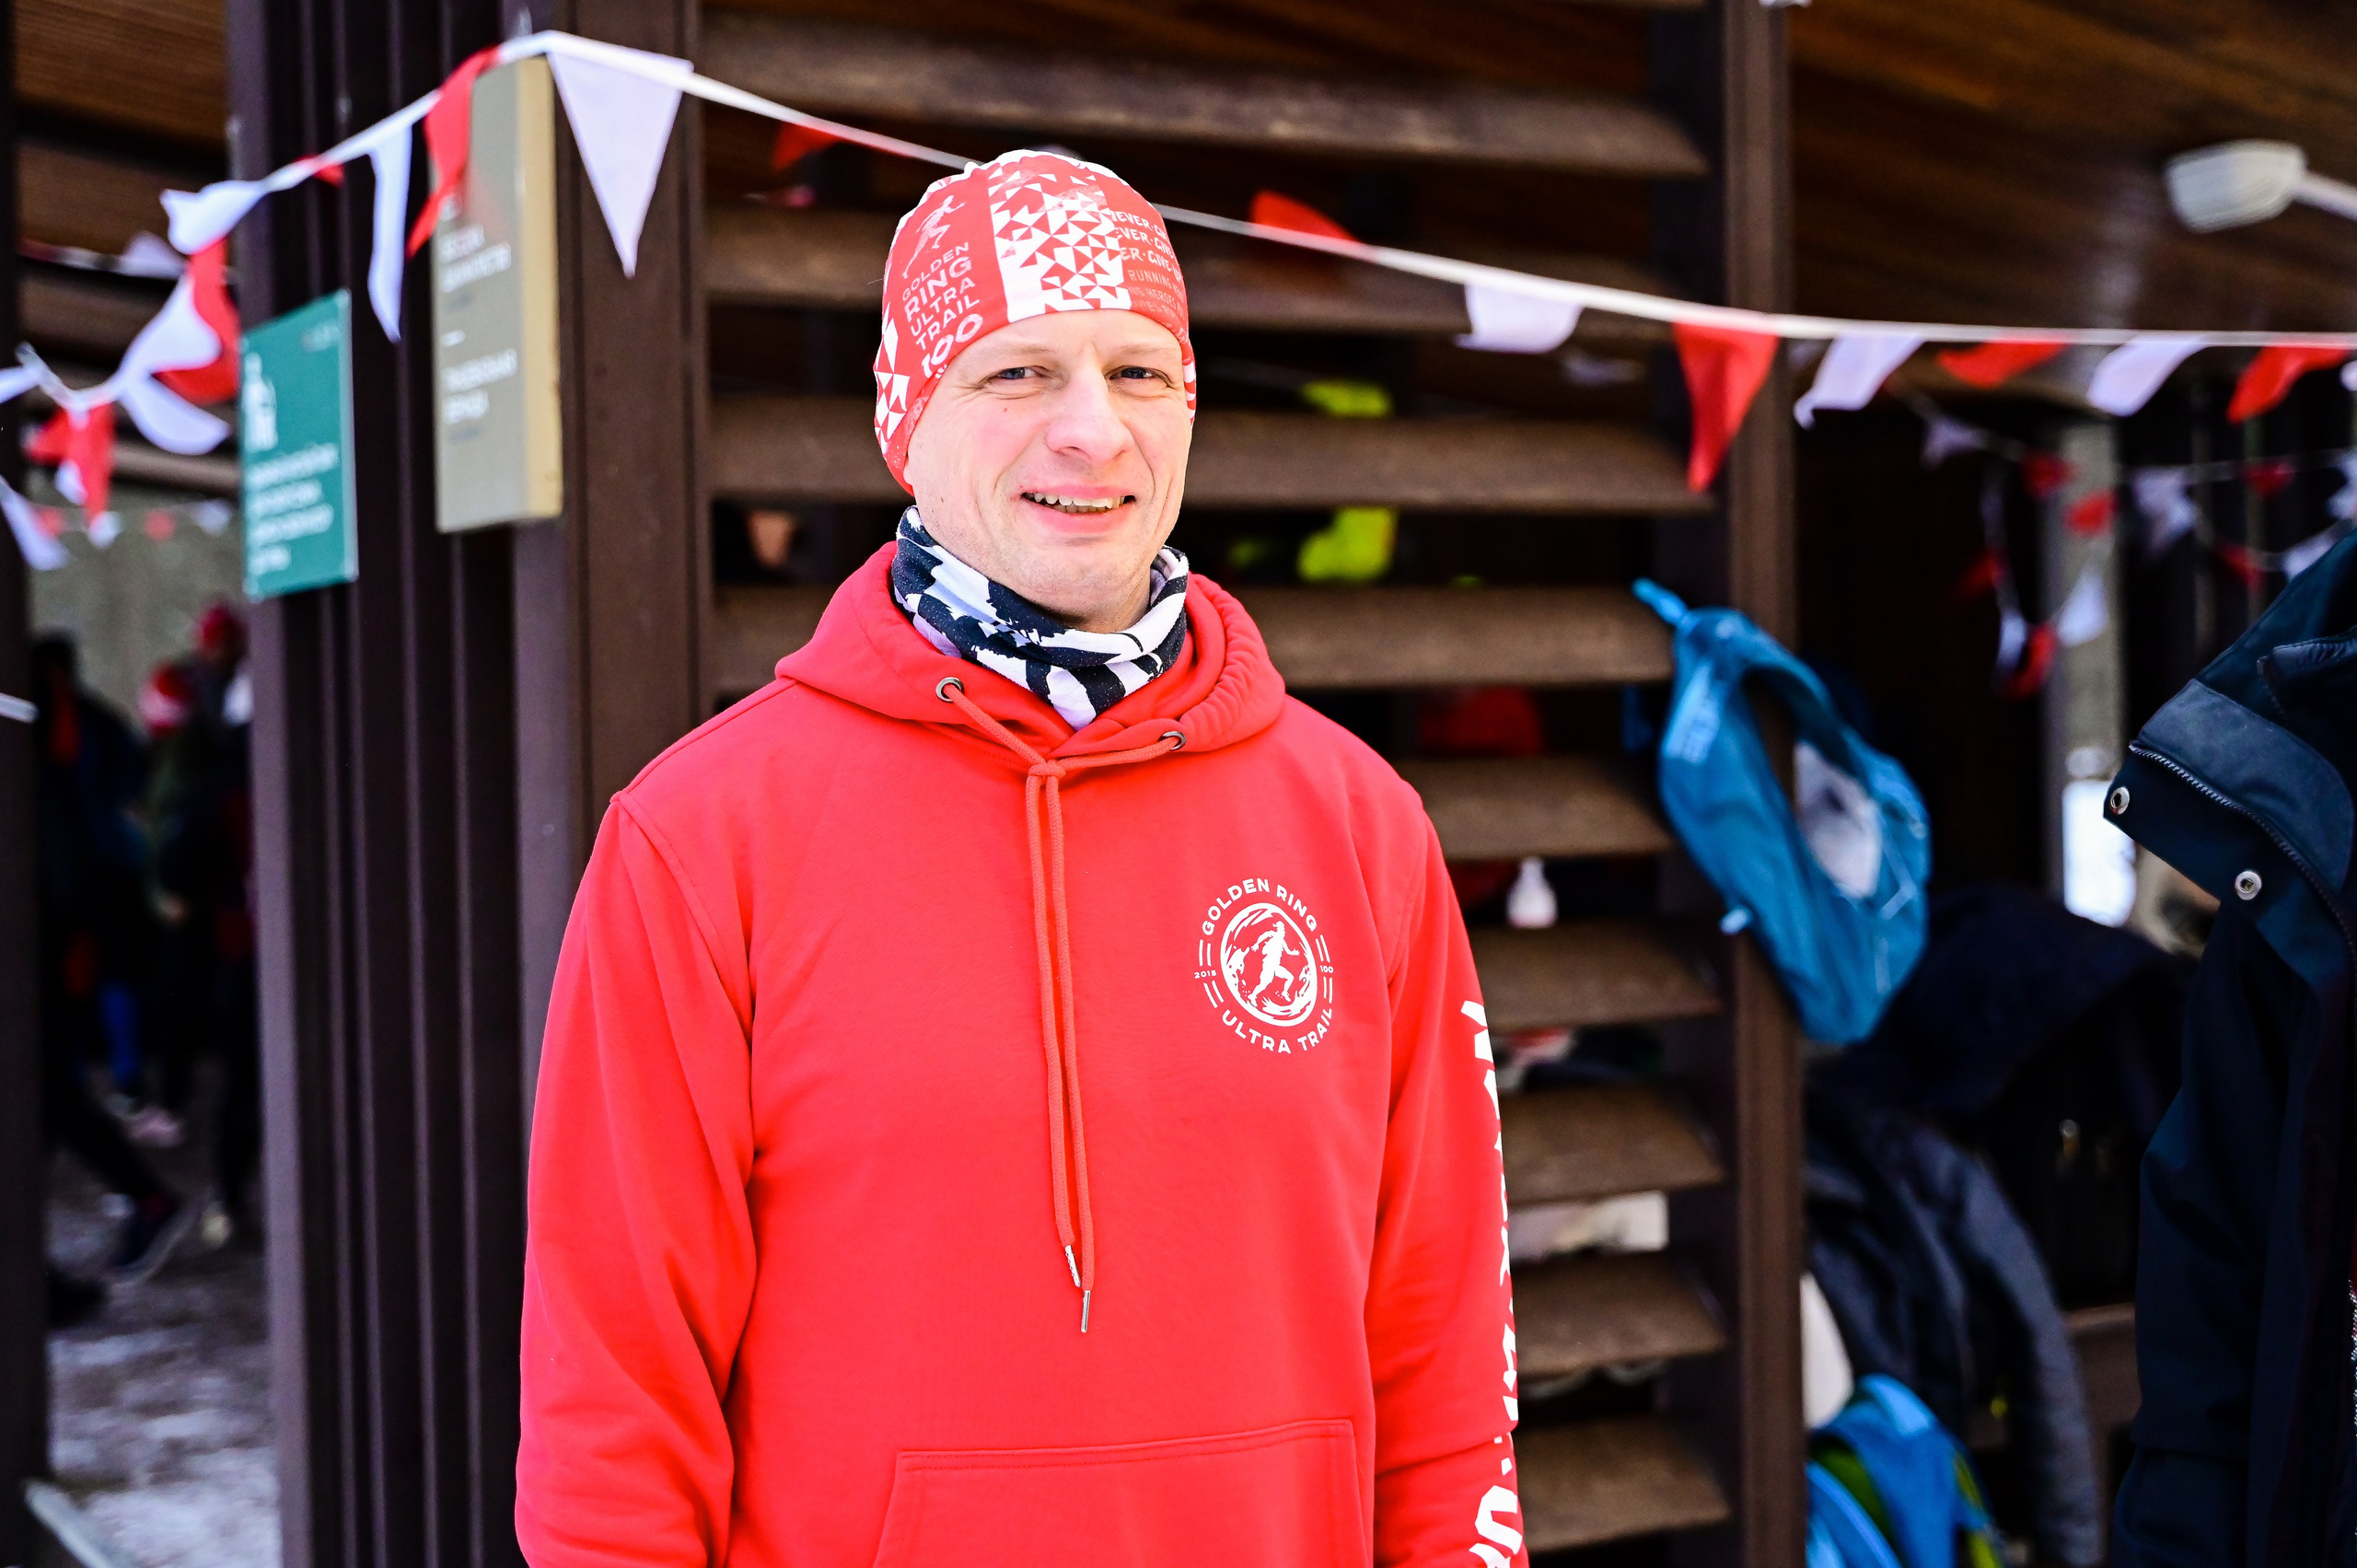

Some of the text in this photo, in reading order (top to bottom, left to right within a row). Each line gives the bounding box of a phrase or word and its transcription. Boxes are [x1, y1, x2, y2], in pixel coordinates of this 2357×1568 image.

[902, 242, 970, 301] GOLDEN
[904, 256, 972, 322] RING
[911, 277, 976, 337] ULTRA
[916, 295, 981, 350] TRAIL
[922, 313, 983, 378] 100
[1202, 877, 1318, 935] GOLDEN RING
[1319, 964, 1334, 974] 100
[1222, 1007, 1332, 1054] ULTRA TRAIL
